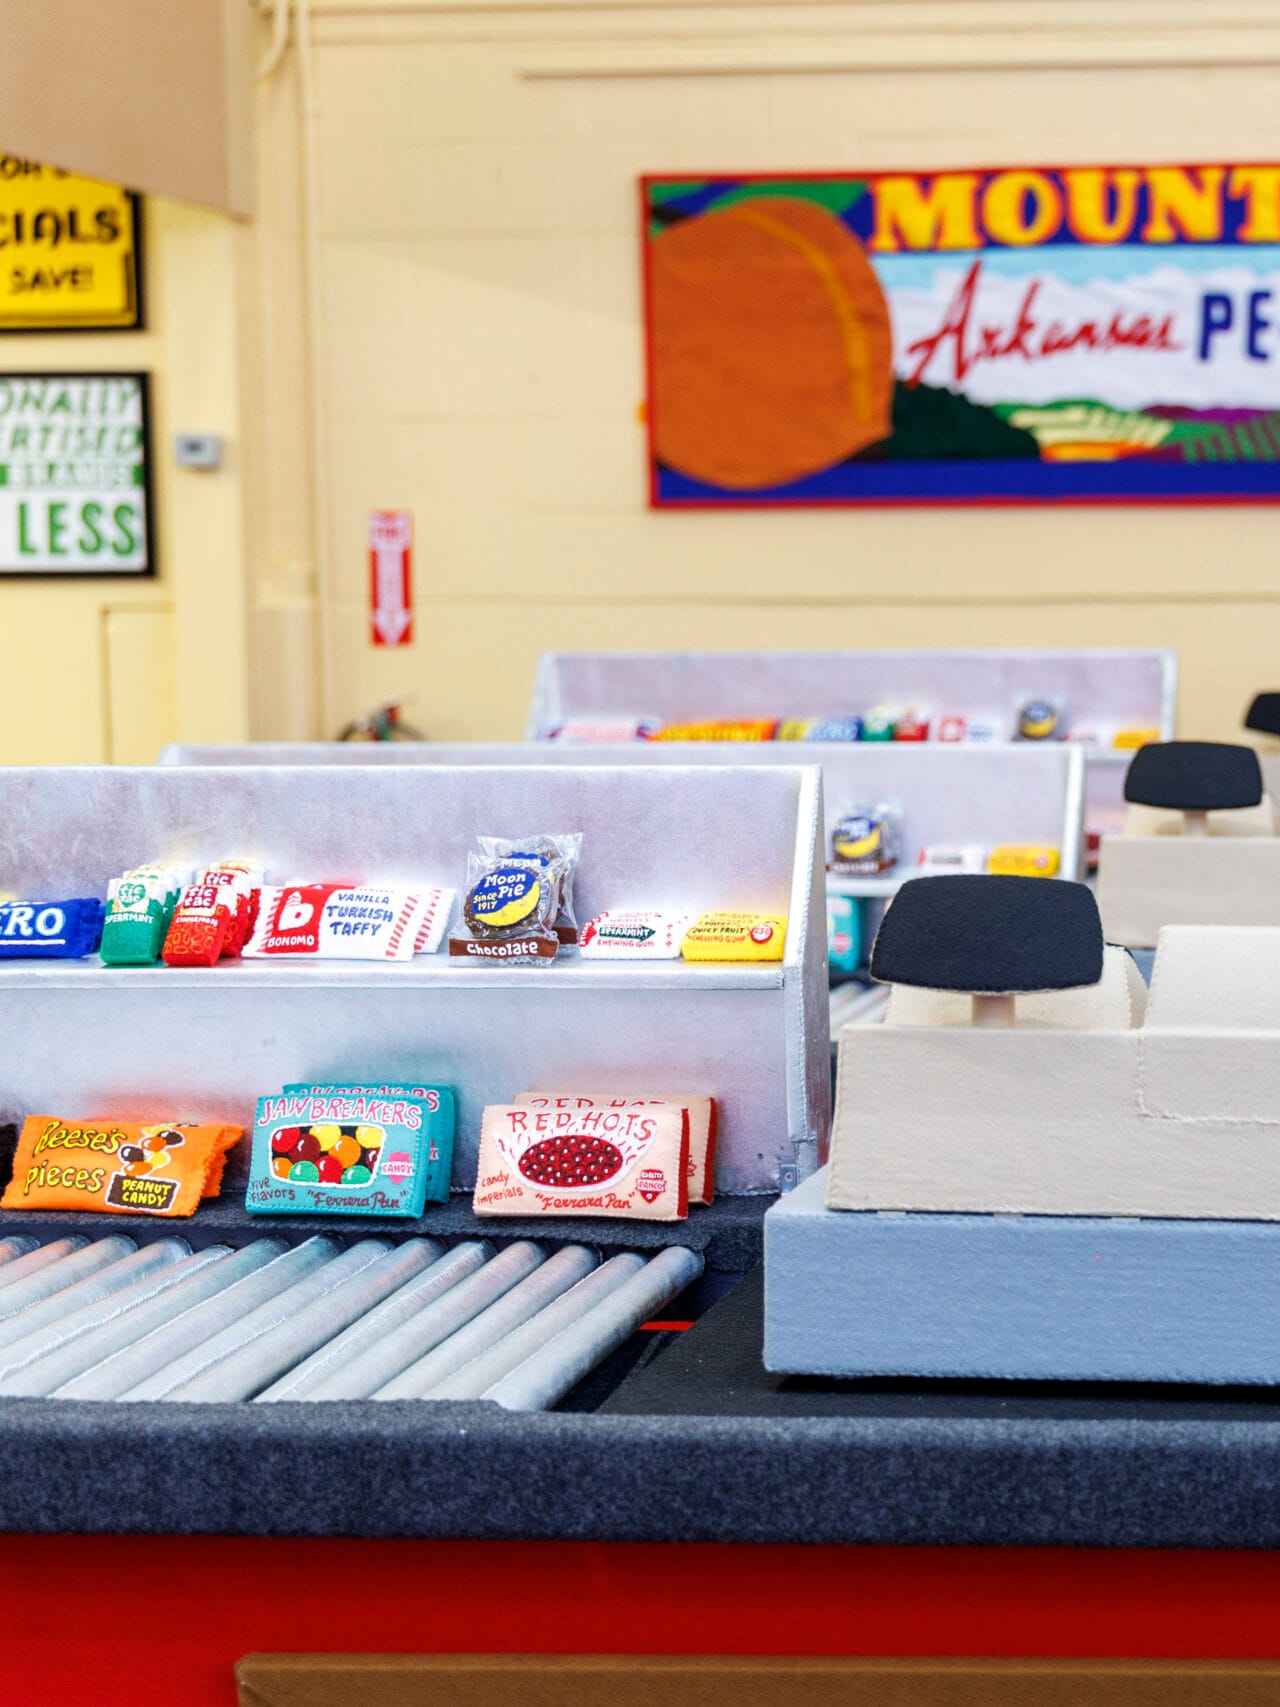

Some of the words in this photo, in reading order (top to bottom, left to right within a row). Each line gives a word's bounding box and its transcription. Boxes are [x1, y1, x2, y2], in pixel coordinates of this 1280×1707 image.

[905, 261, 1184, 388] Arkansas
[18, 502, 136, 556] LESS
[484, 873, 526, 887] Moon
[498, 884, 525, 898] Pie
[338, 893, 389, 905] VANILLA
[477, 901, 498, 911] 1917
[326, 905, 394, 922] TURKISH
[329, 922, 382, 937] TAFFY
[600, 927, 651, 937] SPEARMINT
[266, 935, 315, 948] BONOMO
[466, 941, 538, 956] Chocolate
[506, 1111, 572, 1133] RED
[581, 1112, 657, 1142] HOTS
[32, 1121, 128, 1157] Reese's
[382, 1165, 413, 1174] CANDY
[24, 1160, 107, 1196] pieces
[122, 1178, 172, 1195] PEANUT
[121, 1191, 168, 1207] CANDY
